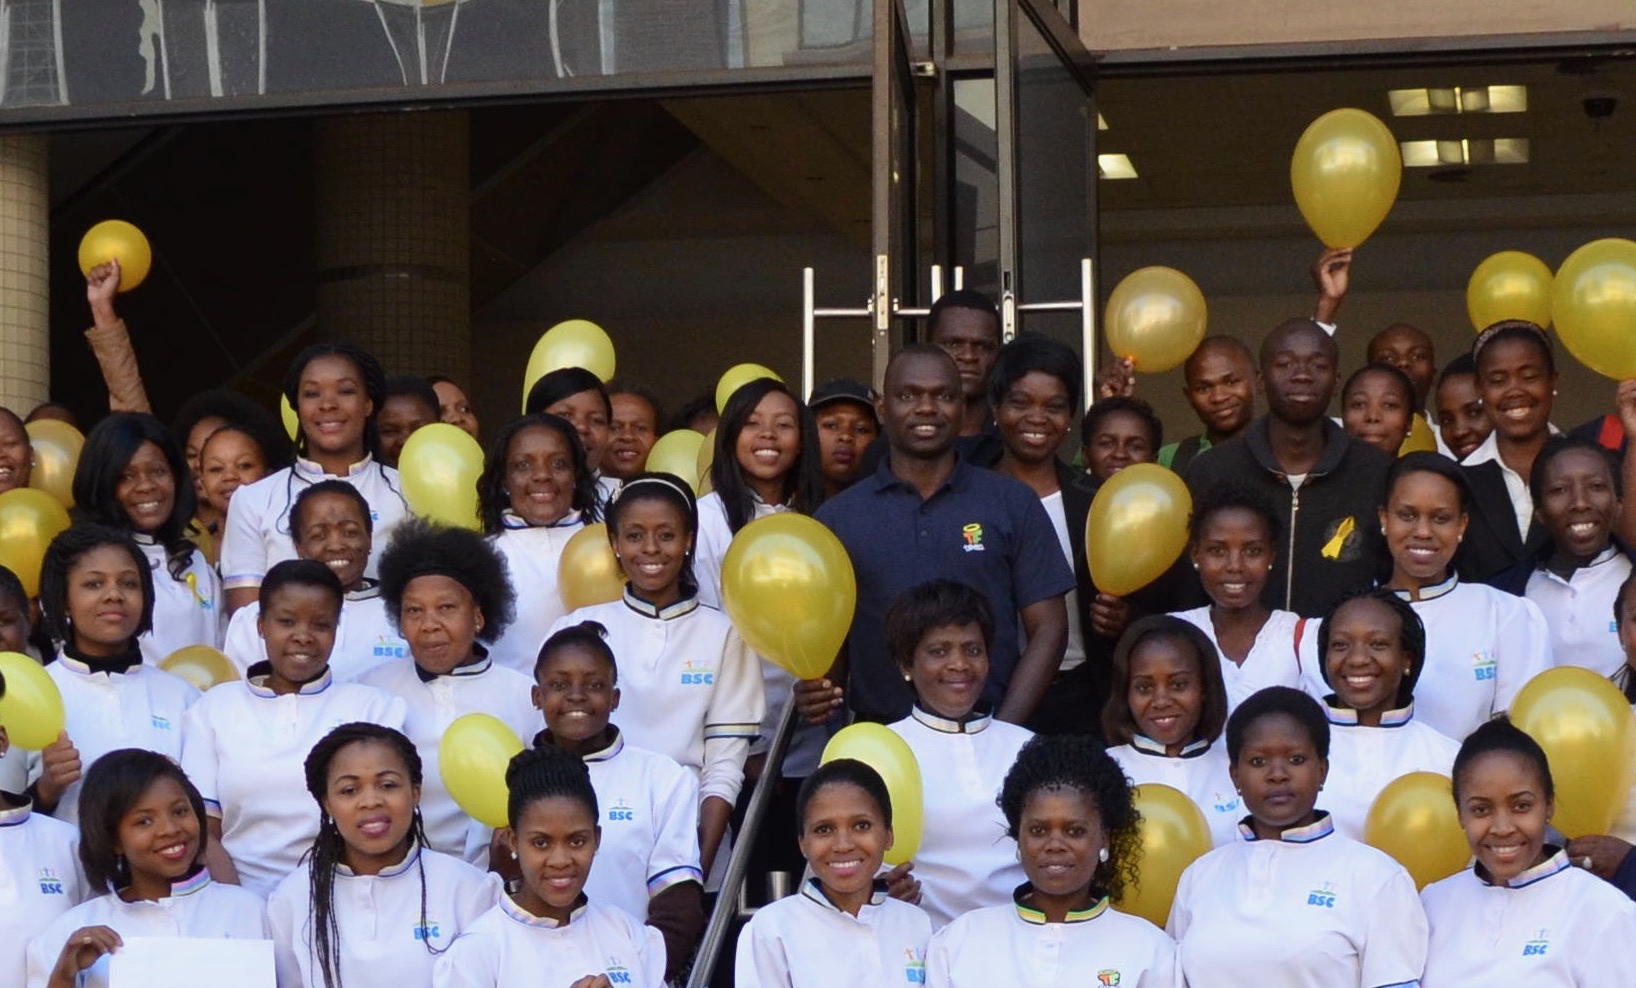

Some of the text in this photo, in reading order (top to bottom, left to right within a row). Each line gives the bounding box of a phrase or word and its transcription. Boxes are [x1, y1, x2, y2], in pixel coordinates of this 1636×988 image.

[373, 647, 404, 659] BSC
[681, 673, 714, 685] BSC
[1475, 667, 1497, 681] BS
[609, 811, 633, 821] BSC
[40, 883, 63, 894] BSC
[1308, 893, 1335, 908] BSC
[1523, 945, 1548, 956] BSC
[609, 971, 631, 983] BSC
